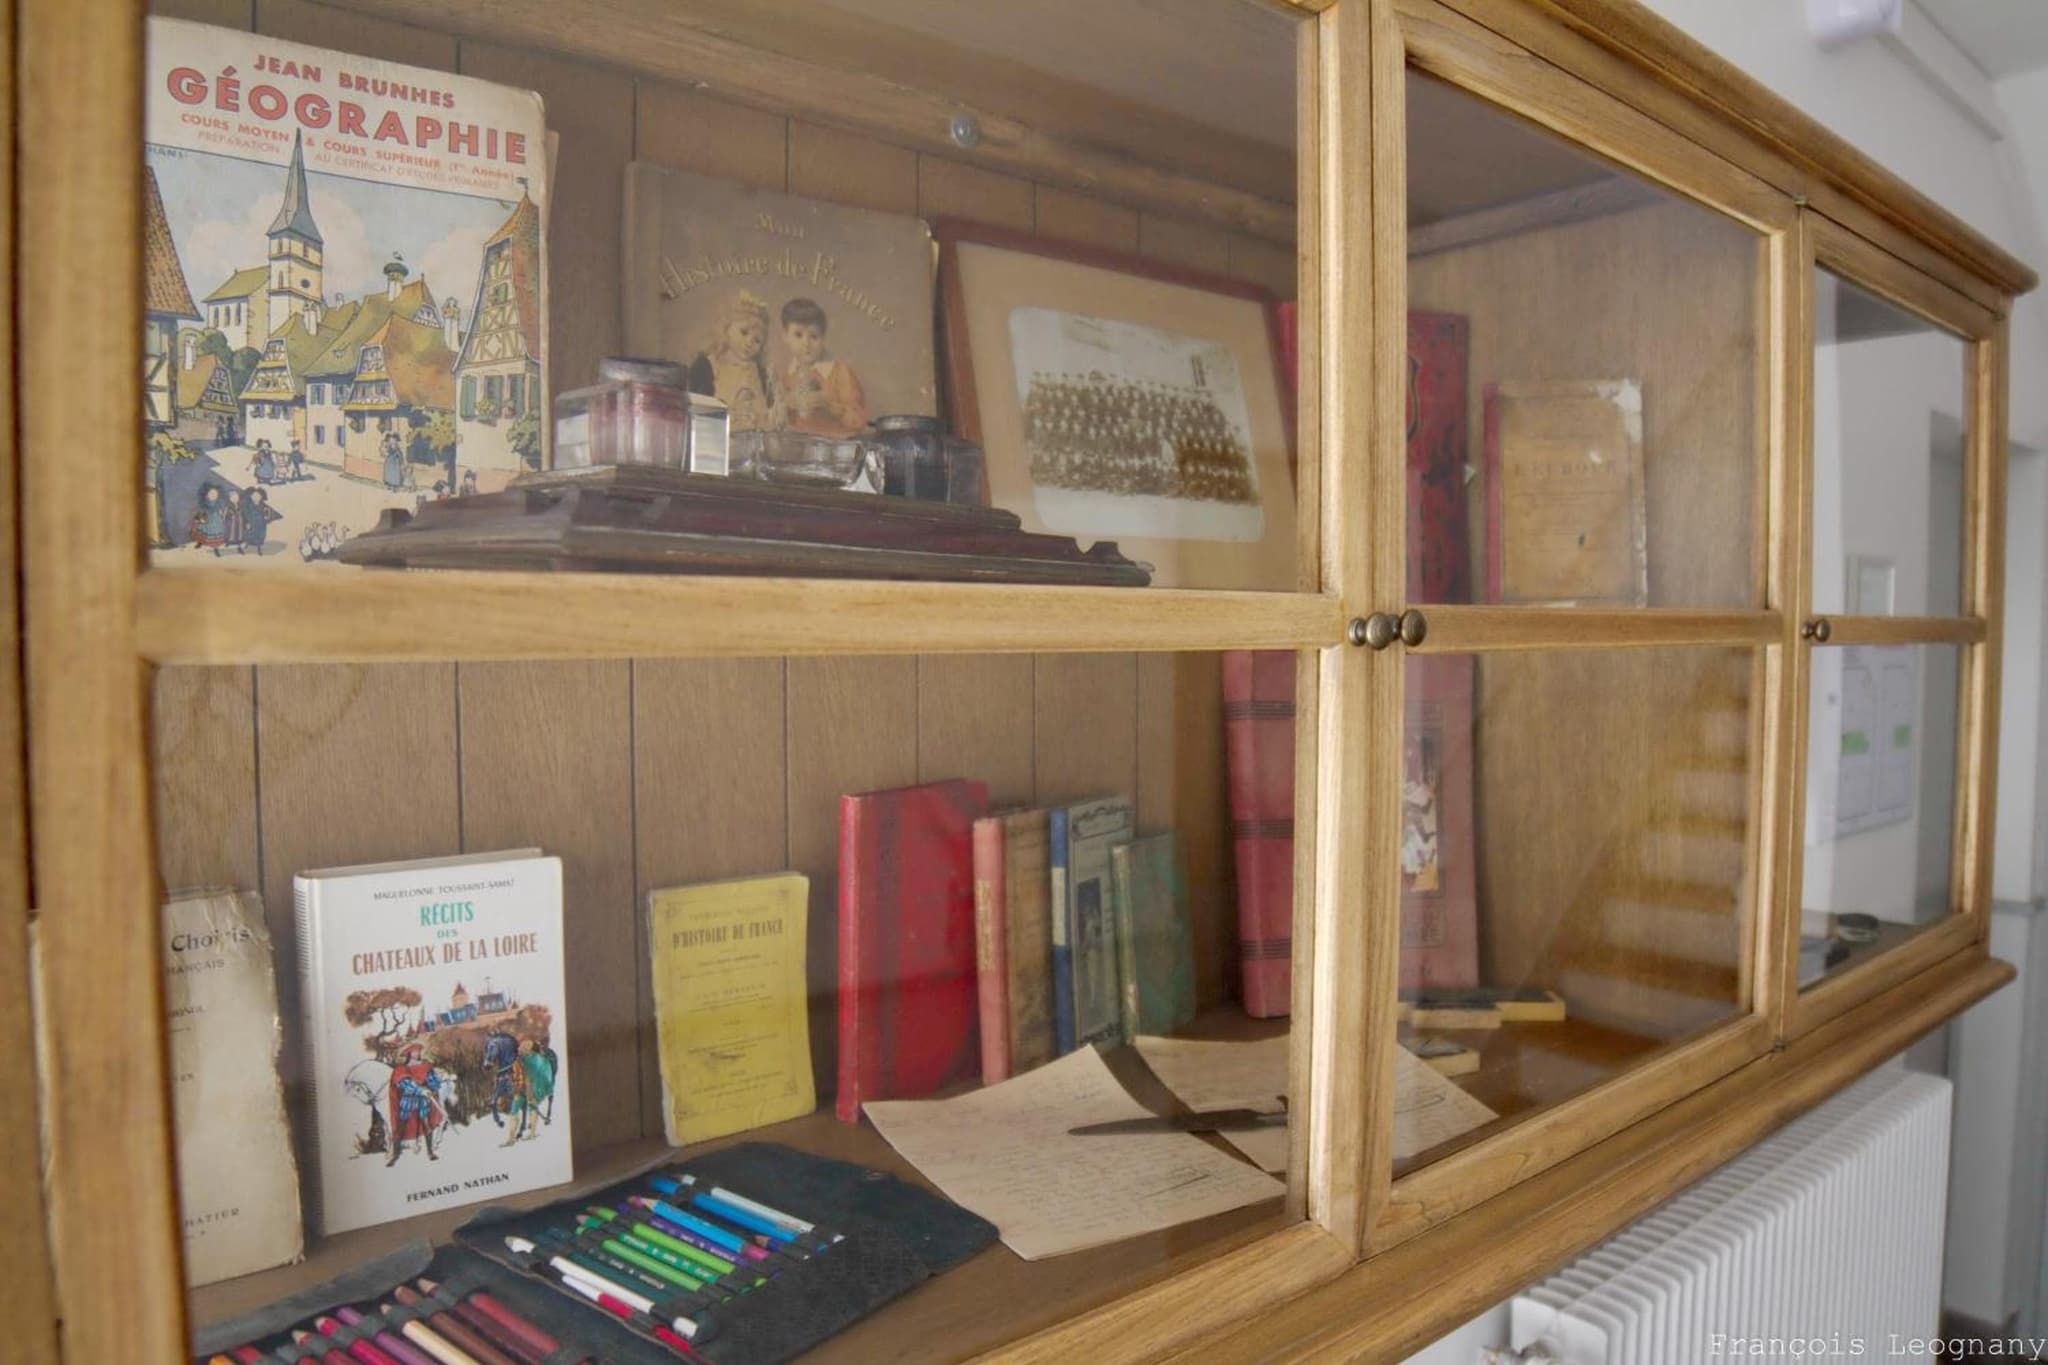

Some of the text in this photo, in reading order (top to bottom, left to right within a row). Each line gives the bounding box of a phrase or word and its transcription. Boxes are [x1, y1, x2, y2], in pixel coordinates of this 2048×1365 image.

[253, 53, 455, 109] JEAN BRUNHES
[166, 65, 527, 165] GÉOGRAPHIE
[181, 113, 229, 131] COURS
[238, 124, 289, 142] MOYEN
[324, 140, 367, 156] COURS
[659, 248, 896, 331] Histoire de France
[437, 929, 458, 939] DES
[750, 918, 783, 938] FRANCE
[352, 933, 538, 976] CHATEAUX DE LA LOIRE
[407, 1173, 510, 1202] FERNAND NATHAN
